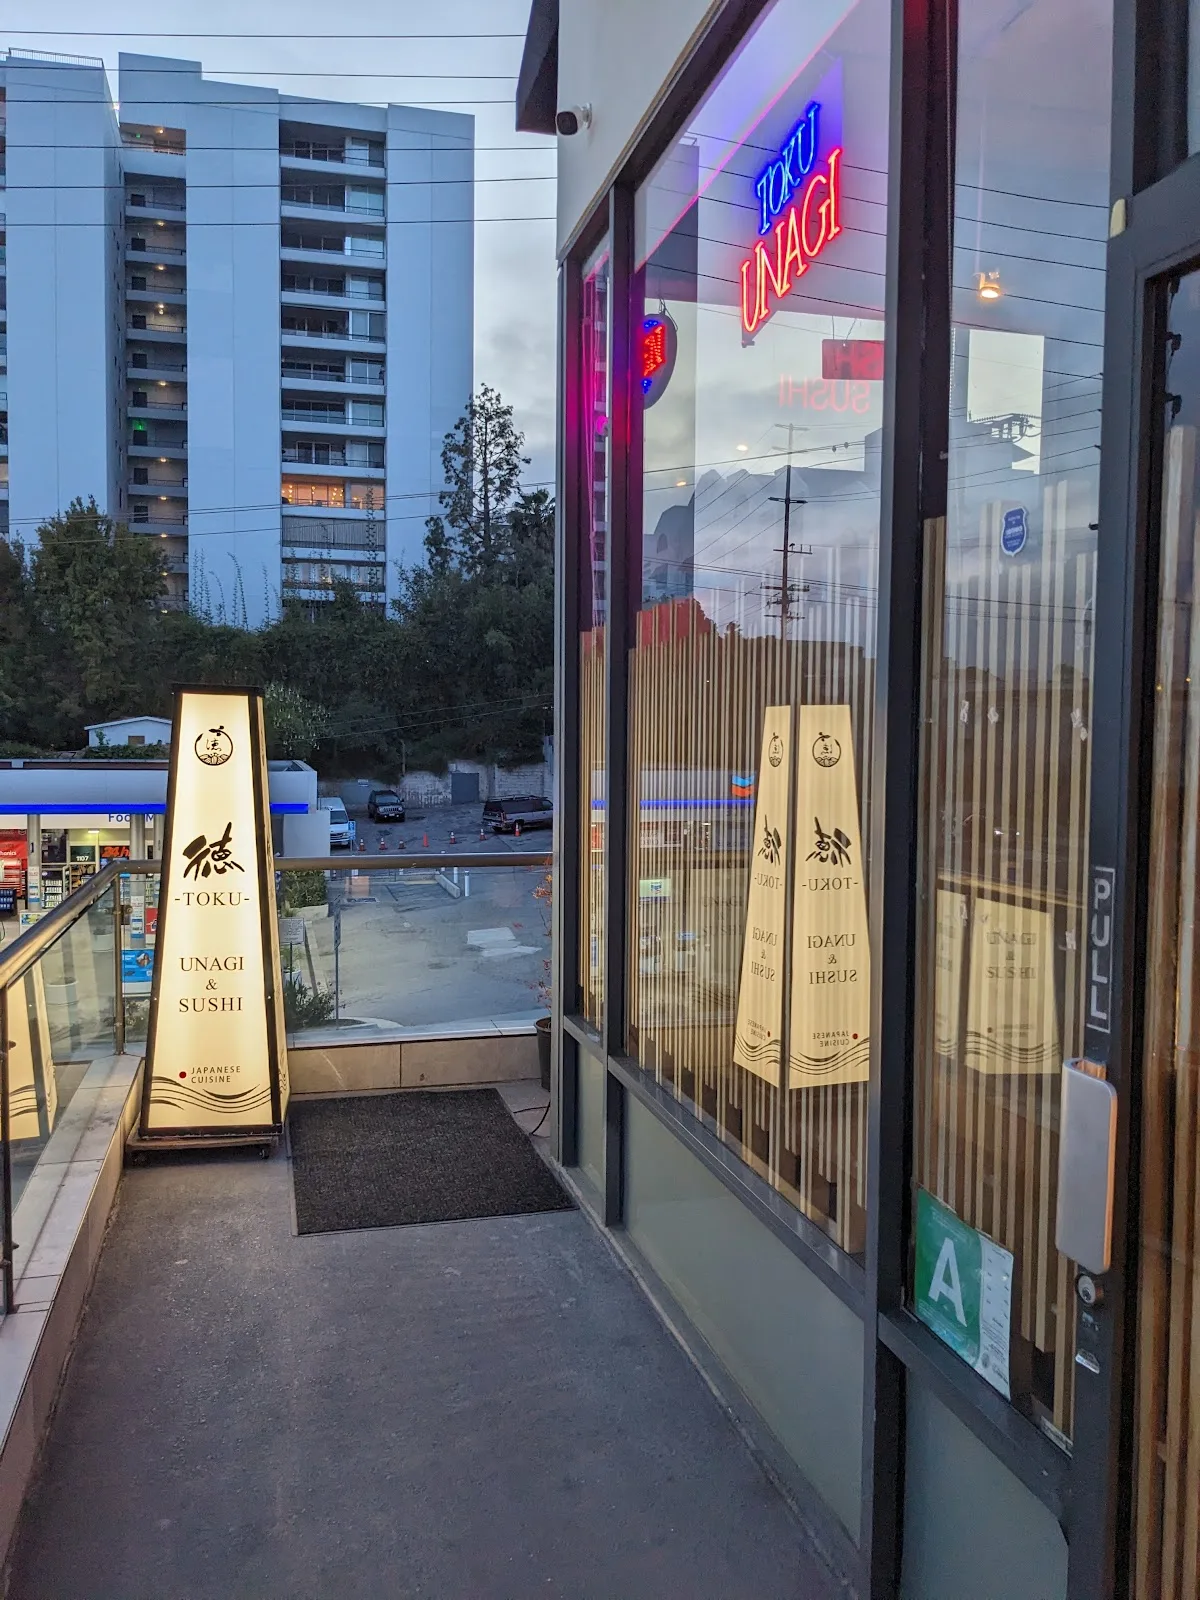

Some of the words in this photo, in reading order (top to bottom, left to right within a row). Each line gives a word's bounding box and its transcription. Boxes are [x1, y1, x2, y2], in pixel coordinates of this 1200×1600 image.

[757, 102, 821, 235] TOKU
[741, 149, 841, 332] UNAGI
[108, 813, 131, 823] FOO
[1090, 877, 1111, 1020] PULL
[178, 956, 245, 972] UNAGI
[205, 978, 218, 991] &
[178, 996, 243, 1013] SUSHI
[191, 1065, 241, 1075] JAPANESE
[190, 1075, 231, 1084] CUISINE
[928, 1236, 969, 1328] A
